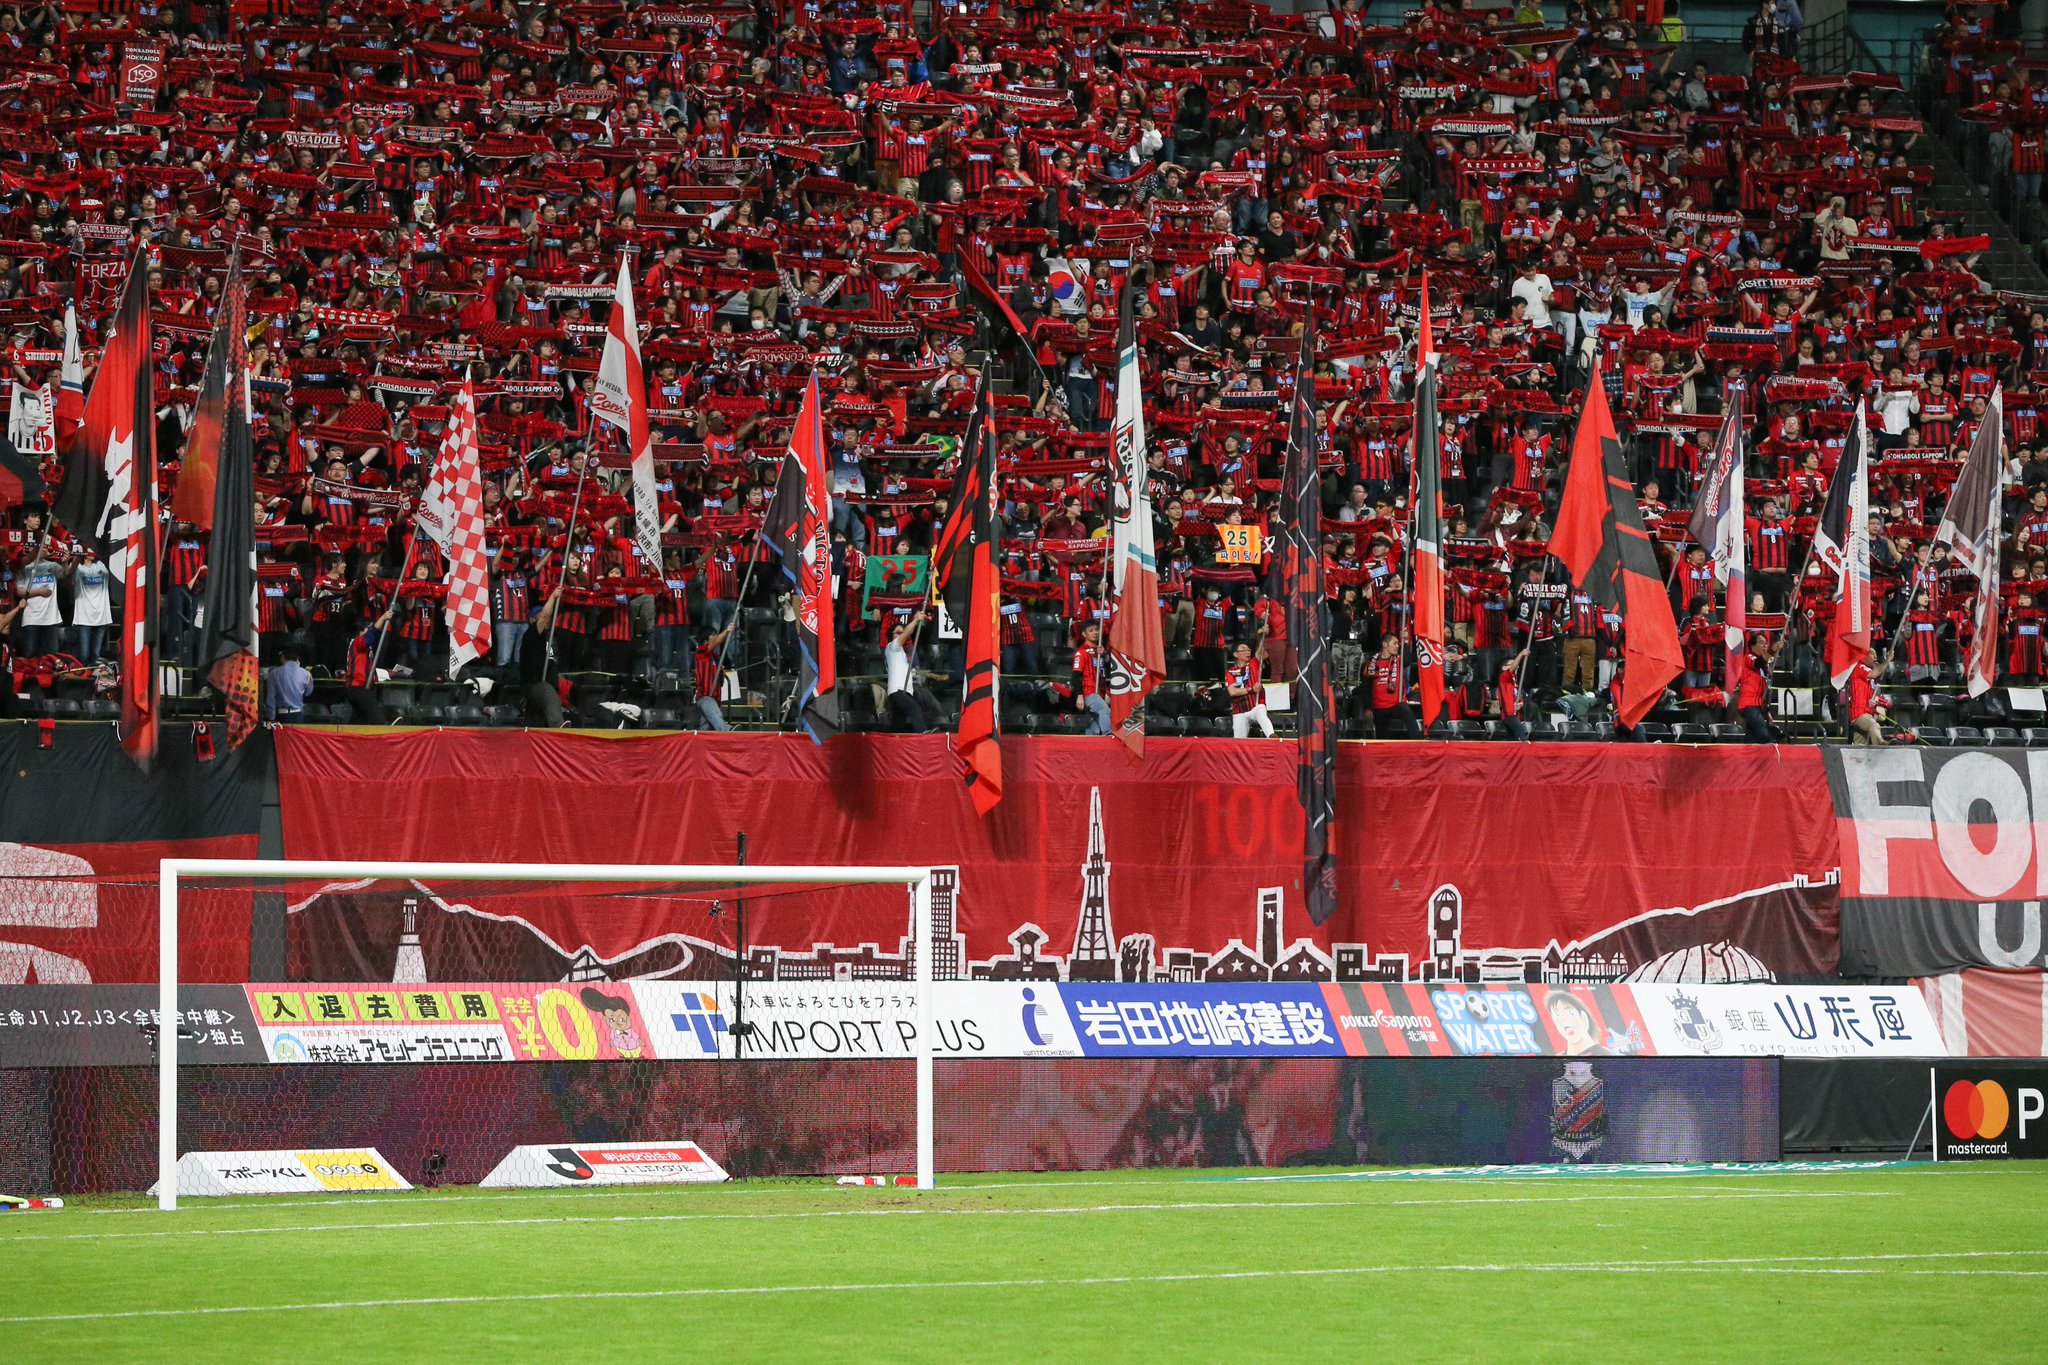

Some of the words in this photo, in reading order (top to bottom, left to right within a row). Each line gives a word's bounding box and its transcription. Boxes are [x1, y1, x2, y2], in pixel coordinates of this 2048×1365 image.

[657, 12, 711, 24] CONSADOLE
[125, 47, 160, 55] CONSADOLE
[125, 54, 160, 62] HOKKAIDO
[132, 67, 153, 78] 150
[81, 260, 126, 277] FORZA
[1790, 277, 1815, 286] FIRE
[1483, 309, 1496, 319] 35
[25, 349, 58, 359] SHINGO
[1227, 530, 1247, 546] 25
[1067, 542, 1099, 550] SAPPORO
[882, 559, 917, 585] 25
[899, 614, 908, 624] 41
[1008, 613, 1018, 624] 10
[272, 994, 487, 1019] 入退去費用
[501, 997, 534, 1014] 完全
[1435, 991, 1536, 1022] SPORTS
[1075, 999, 1335, 1047] 岩田地崎建設
[1725, 1009, 1772, 1032] 銀座
[1774, 994, 1913, 1047] 山形屋
[1407, 1030, 1439, 1042] 北海道
[1445, 1023, 1540, 1053] WATER
[1740, 1044, 1786, 1054] TOKYO
[1790, 1046, 1819, 1054] SINCE
[1824, 1044, 1856, 1054] 1907
[601, 1152, 682, 1162] 明治安田生命
[218, 1166, 307, 1178] スポーツくじ
[636, 1164, 693, 1173] LEAGUE
